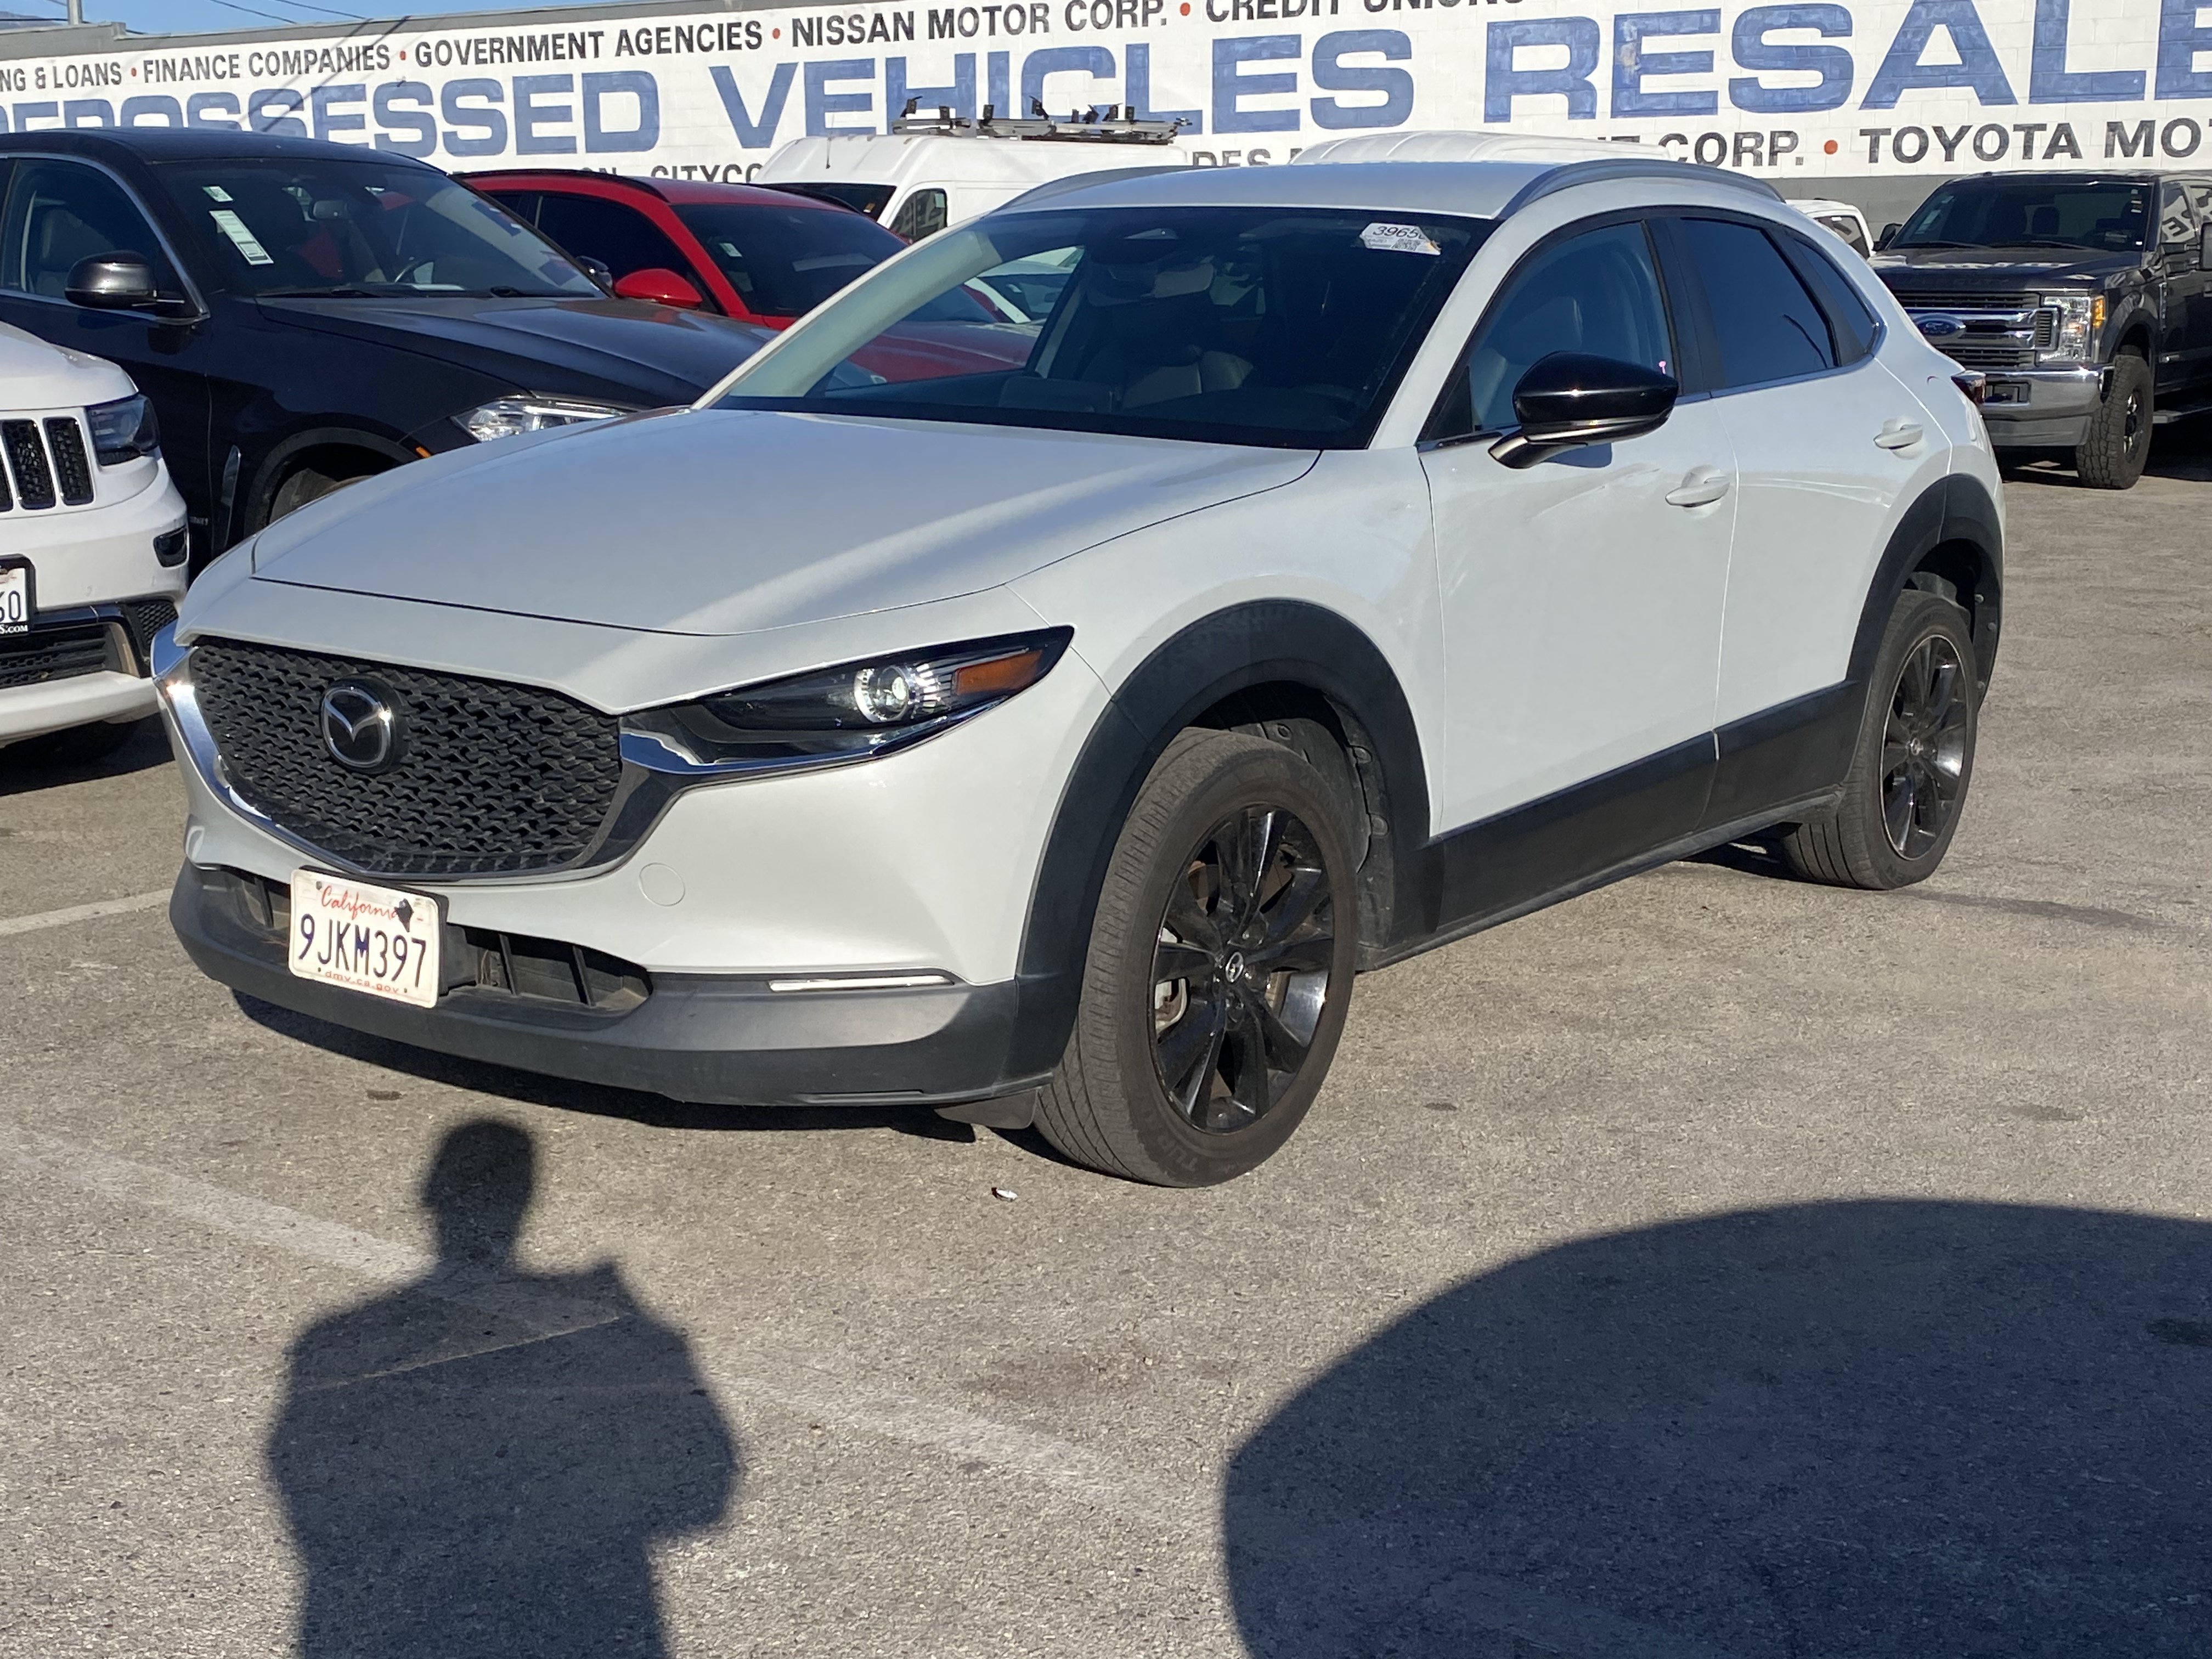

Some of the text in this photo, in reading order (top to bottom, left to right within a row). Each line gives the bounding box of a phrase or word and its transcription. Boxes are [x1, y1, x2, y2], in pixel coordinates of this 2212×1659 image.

[0, 68, 26, 92] NG
[35, 67, 46, 89] &
[53, 61, 122, 89] LOANS
[143, 54, 240, 83] FINANCE
[248, 44, 391, 76] COMPANIES
[415, 31, 605, 67] GOVERNMENT
[614, 21, 763, 57] AGENCIES
[792, 10, 915, 47] NISSAN
[928, 3, 1051, 39] MOTOR
[1065, 0, 1167, 31] CORP.
[708, 29, 1414, 149] VEHICLES
[1860, 122, 2083, 163] TOYOTA
[2104, 118, 2212, 158] MO
[321, 885, 398, 920] California
[298, 914, 426, 988] 9JKM397
[325, 970, 399, 994] dmv.ca.gov
